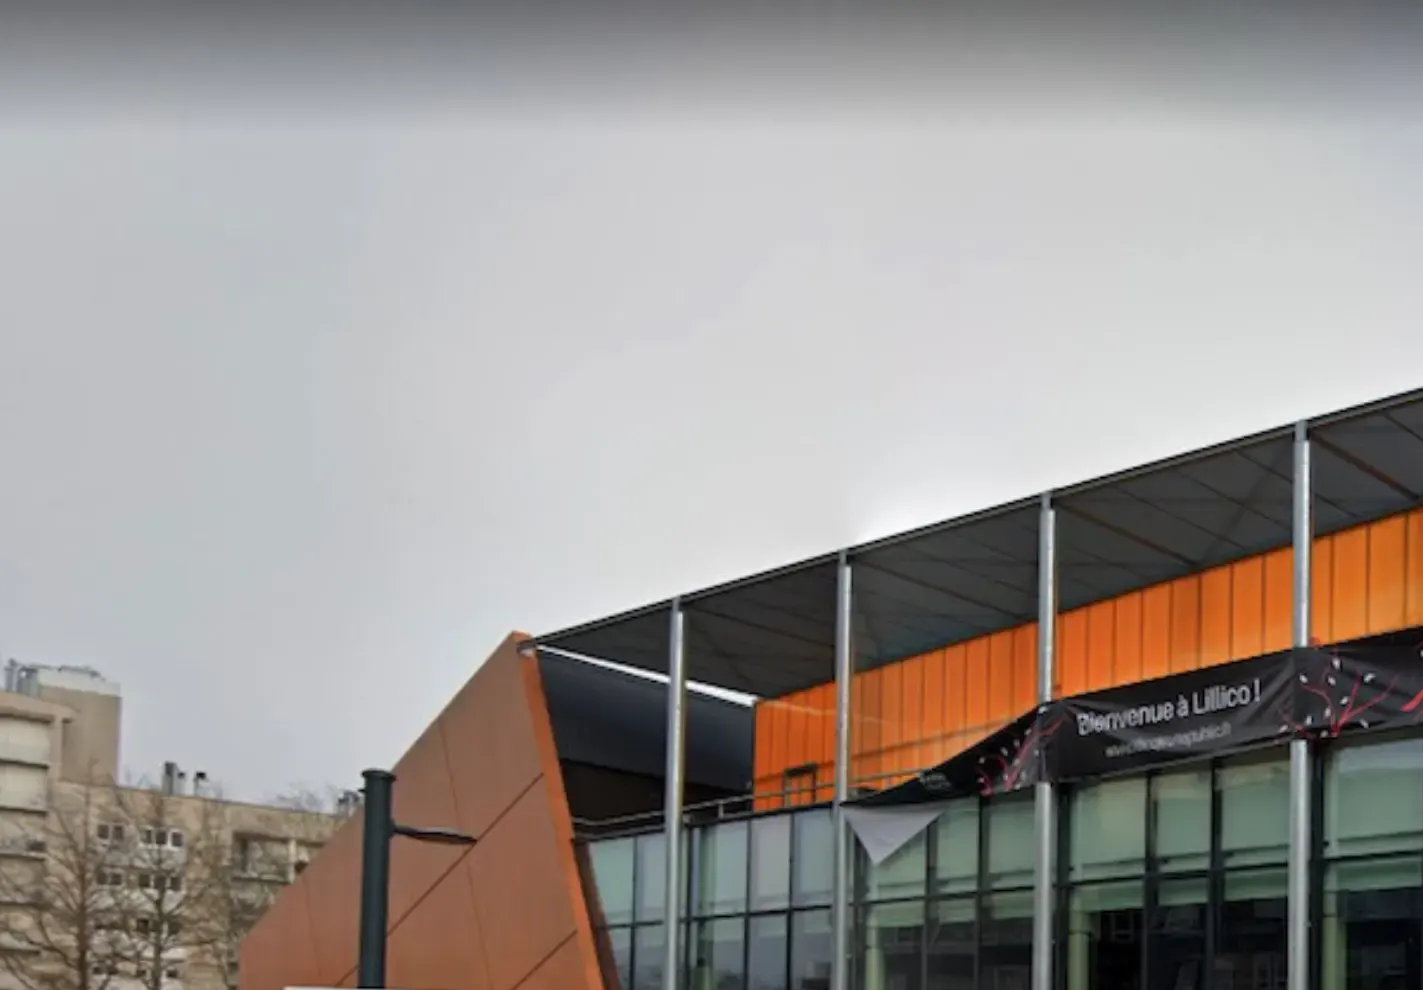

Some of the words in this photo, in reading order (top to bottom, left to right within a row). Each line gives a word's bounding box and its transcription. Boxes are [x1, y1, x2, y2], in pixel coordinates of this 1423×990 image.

[1076, 701, 1174, 736] Bienvenue
[1177, 694, 1189, 717] à
[1192, 684, 1251, 715] Lillico
